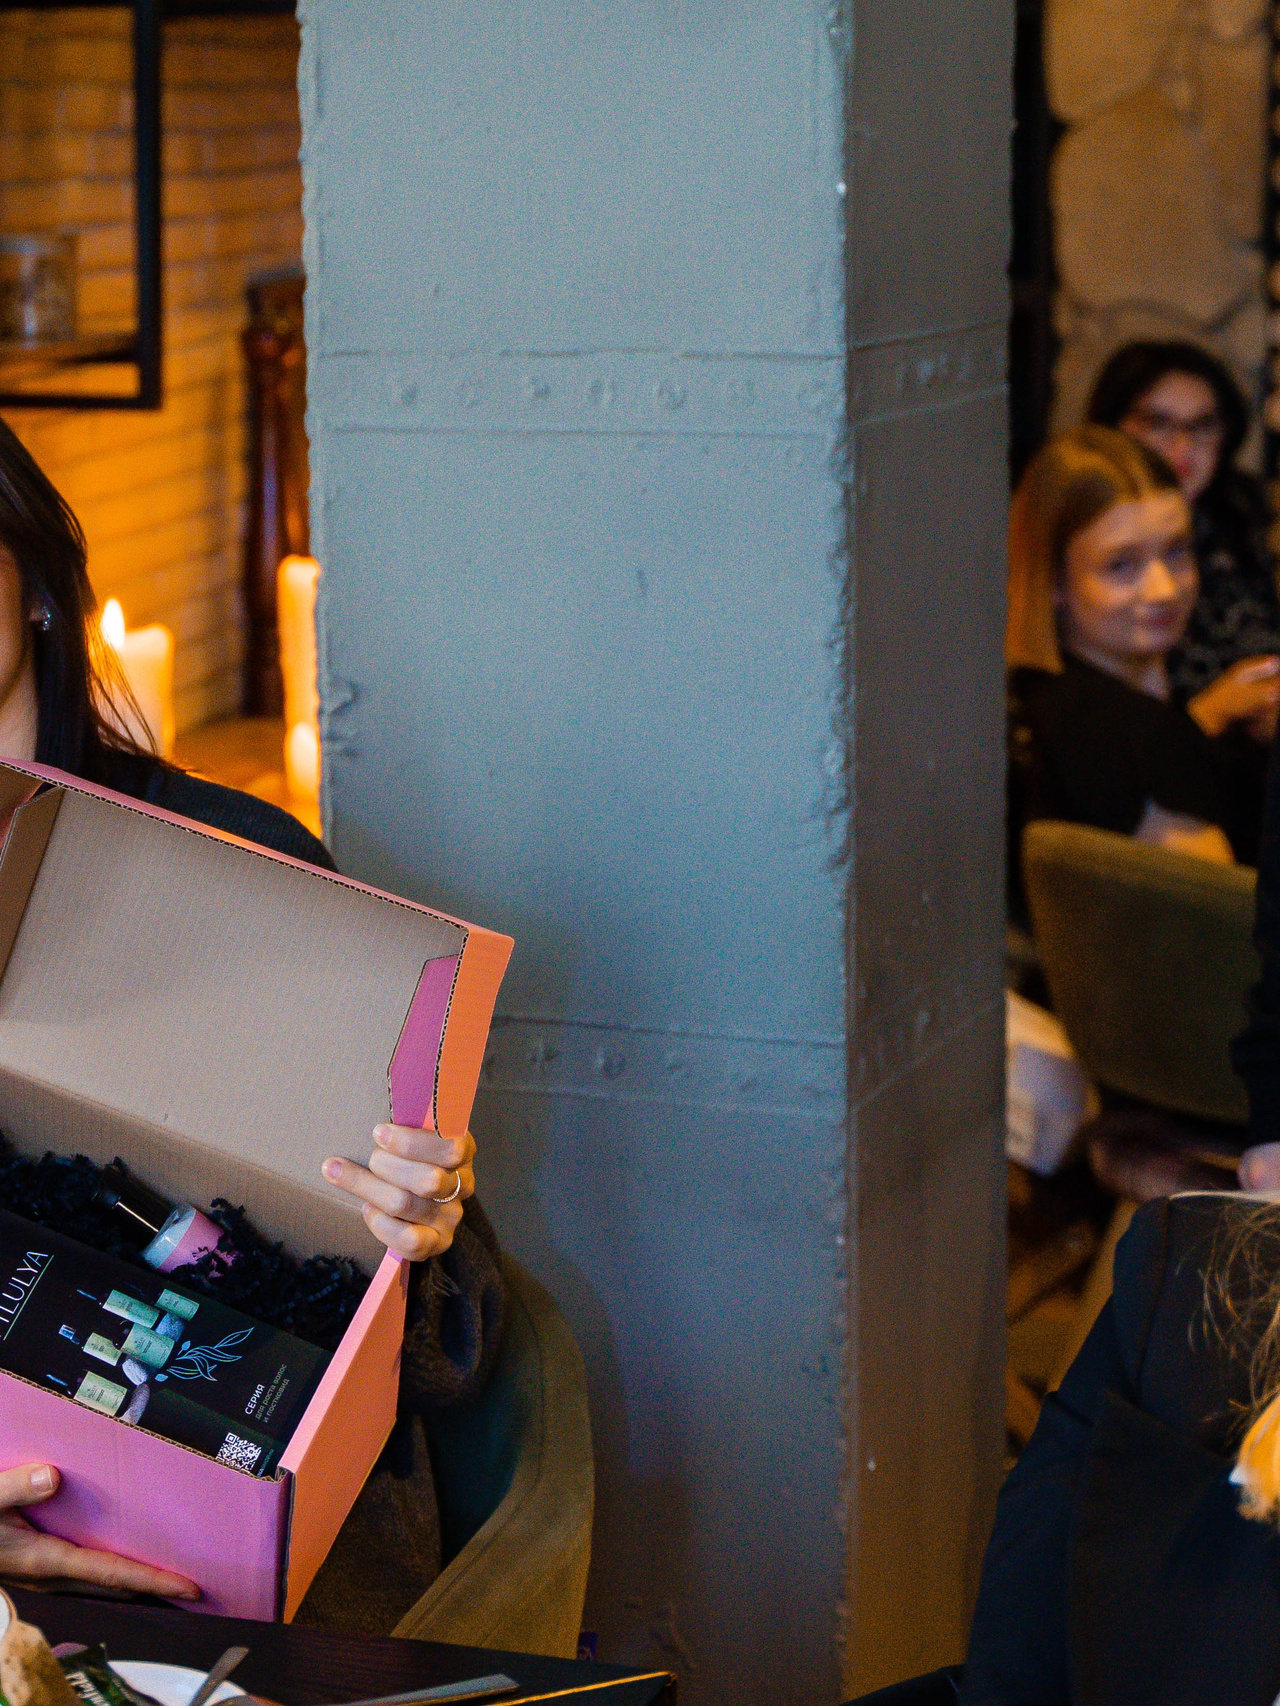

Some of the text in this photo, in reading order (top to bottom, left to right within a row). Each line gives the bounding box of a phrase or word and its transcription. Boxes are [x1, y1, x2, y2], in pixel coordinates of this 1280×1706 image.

[245, 1384, 265, 1415] СЕРИЯ
[256, 1364, 287, 1420] для роста волос
[266, 1379, 290, 1417] постковид
